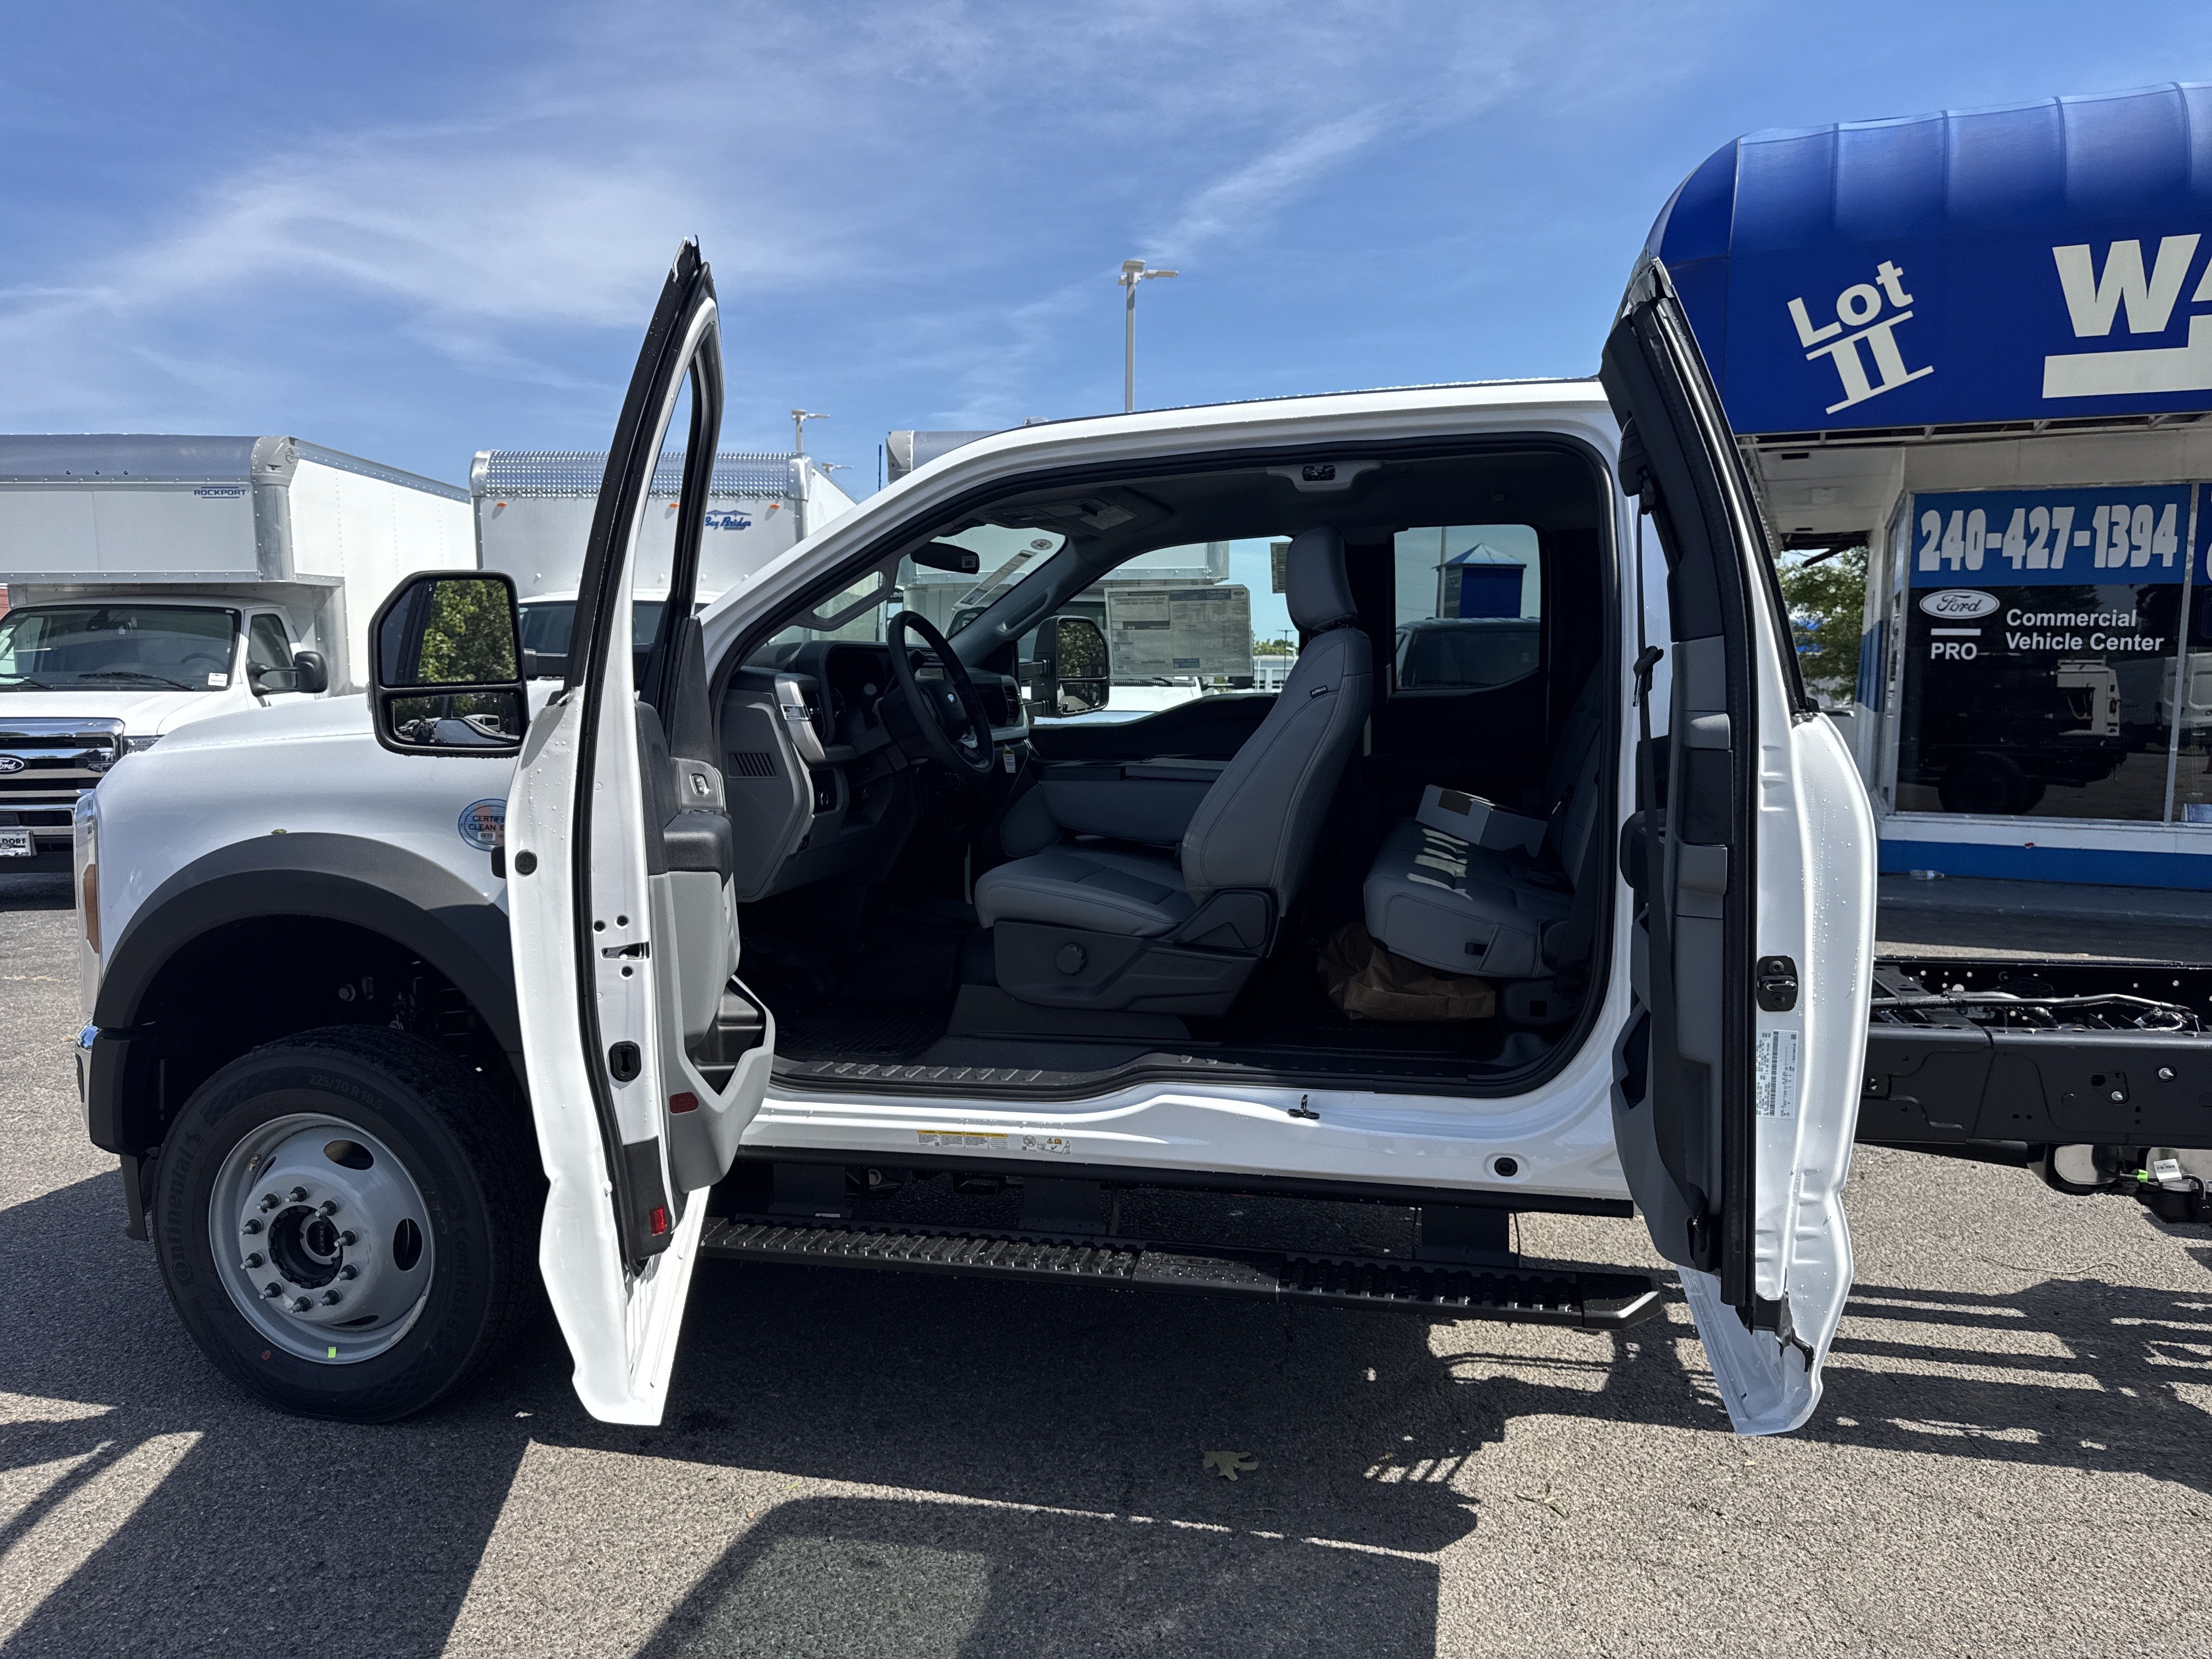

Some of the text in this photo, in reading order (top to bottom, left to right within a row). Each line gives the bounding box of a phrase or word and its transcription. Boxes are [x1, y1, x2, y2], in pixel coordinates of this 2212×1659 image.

[2051, 233, 2212, 337] W
[1787, 260, 1914, 348] Lot
[1805, 311, 1934, 415] II
[705, 516, 752, 531] Bay Bridge
[1918, 504, 2178, 571] 240-427-1394
[1936, 594, 1982, 613] Ford
[2006, 608, 2137, 627] Commercial
[1931, 642, 1978, 659] PRO
[2006, 632, 2165, 651] Vehicle Center
[309, 1074, 349, 1093] 225/70
[362, 1091, 384, 1110] 19.5
[166, 1144, 195, 1286] Continental
